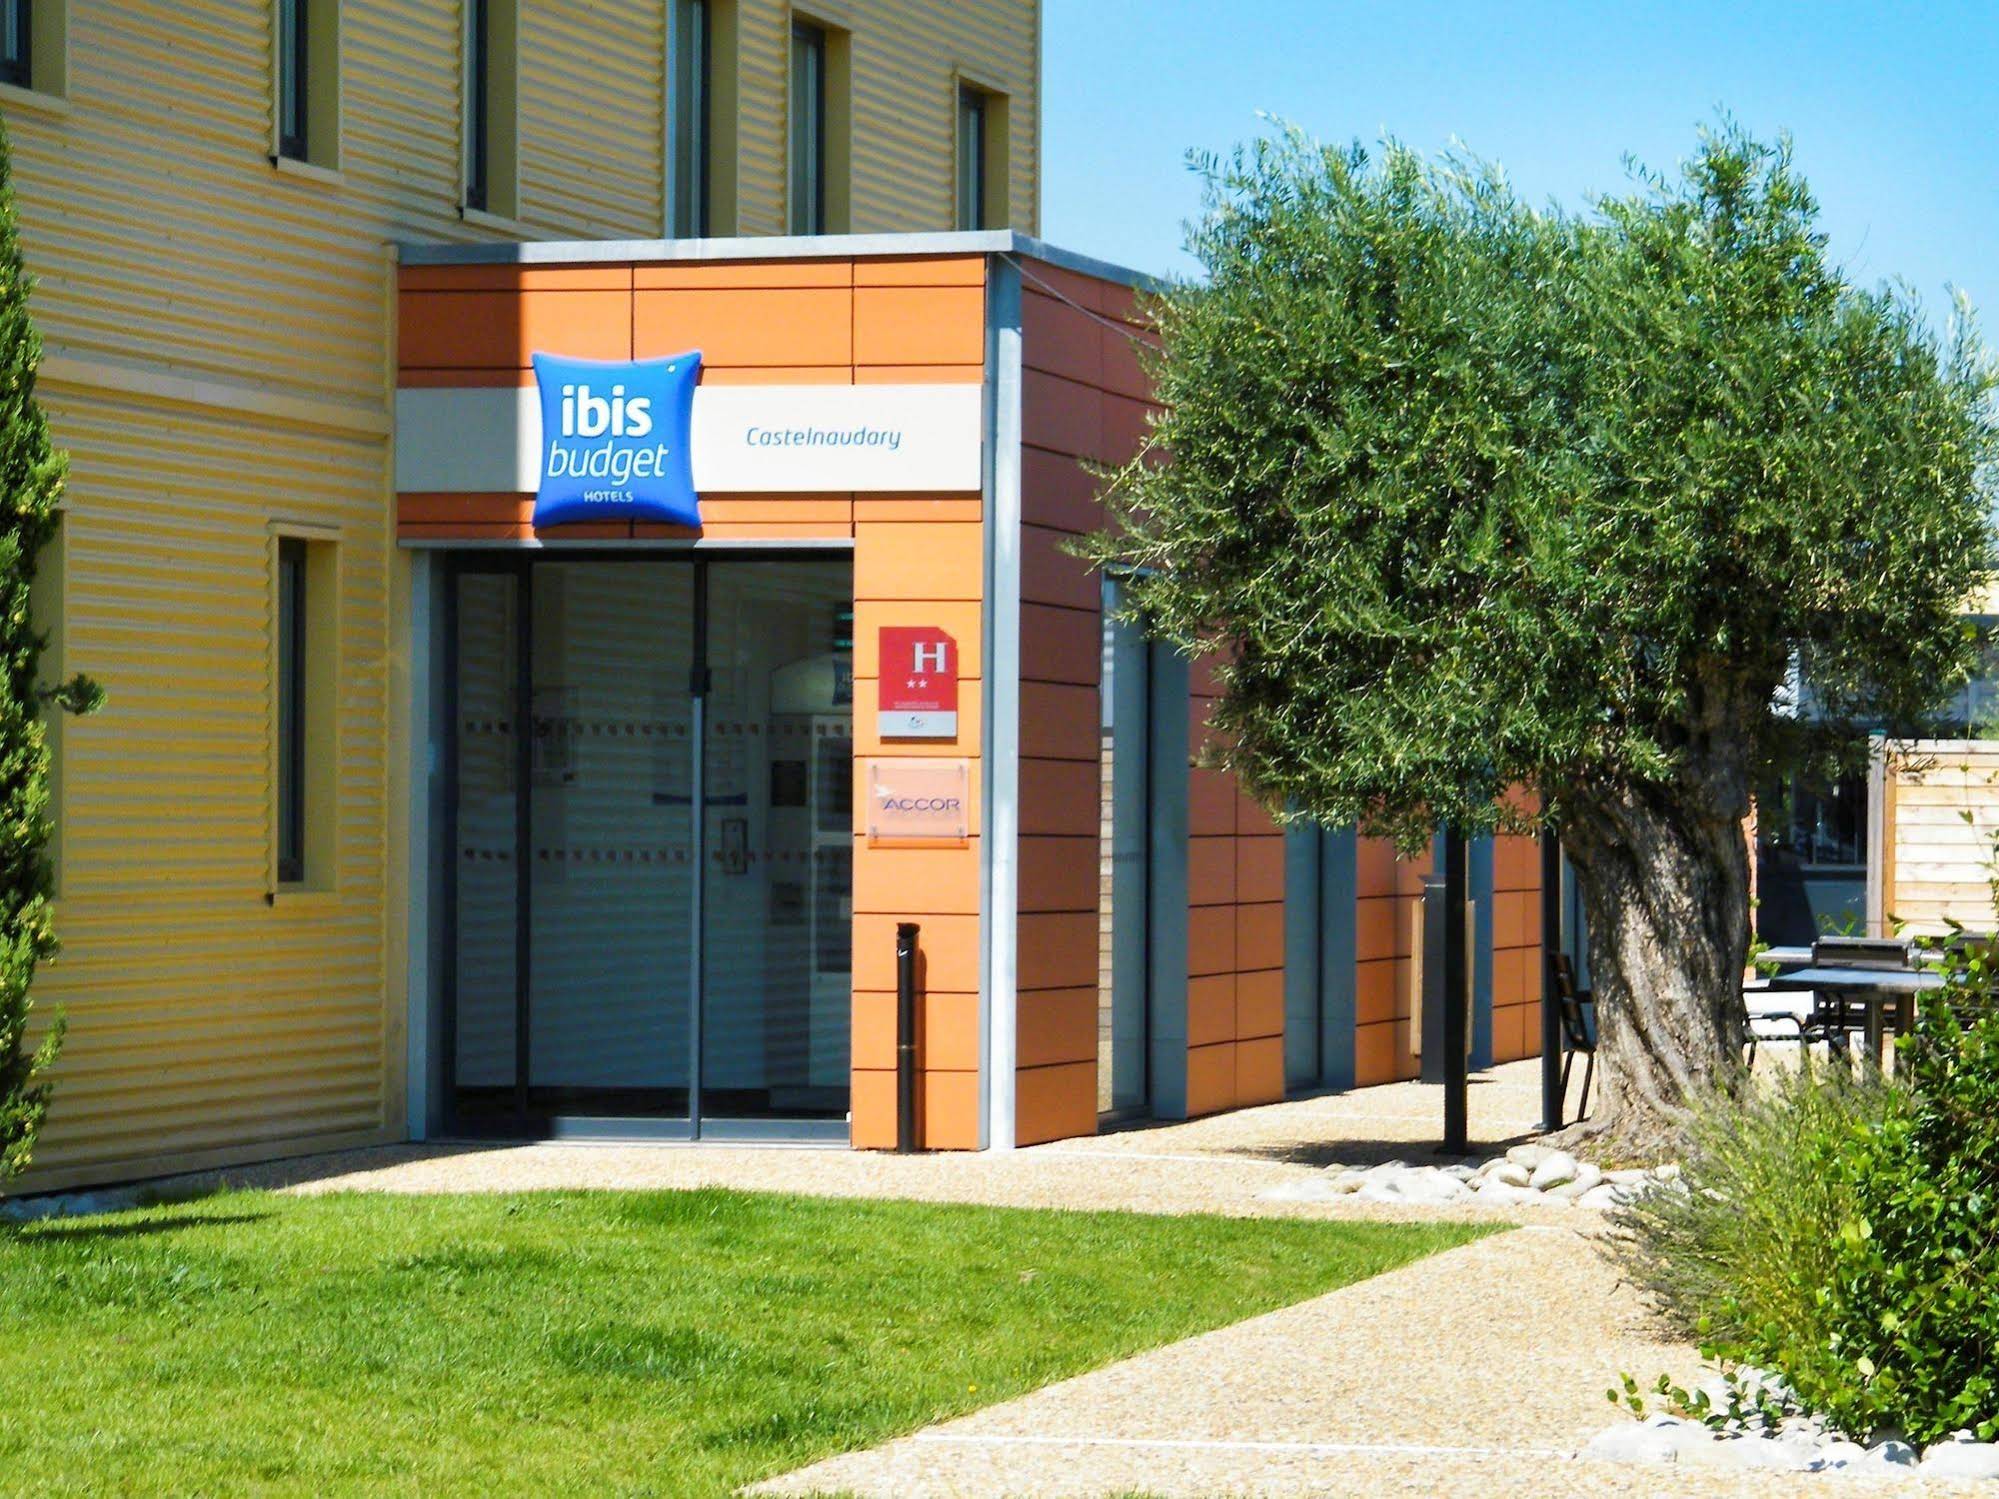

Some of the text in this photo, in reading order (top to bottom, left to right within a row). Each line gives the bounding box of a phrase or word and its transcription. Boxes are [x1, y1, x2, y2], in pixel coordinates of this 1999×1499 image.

[562, 384, 653, 437] ibis
[746, 427, 901, 450] Castelnaudary
[547, 440, 669, 486] budget
[583, 491, 634, 503] HOTELS
[913, 641, 948, 673] H
[883, 798, 960, 811] ACCOR
